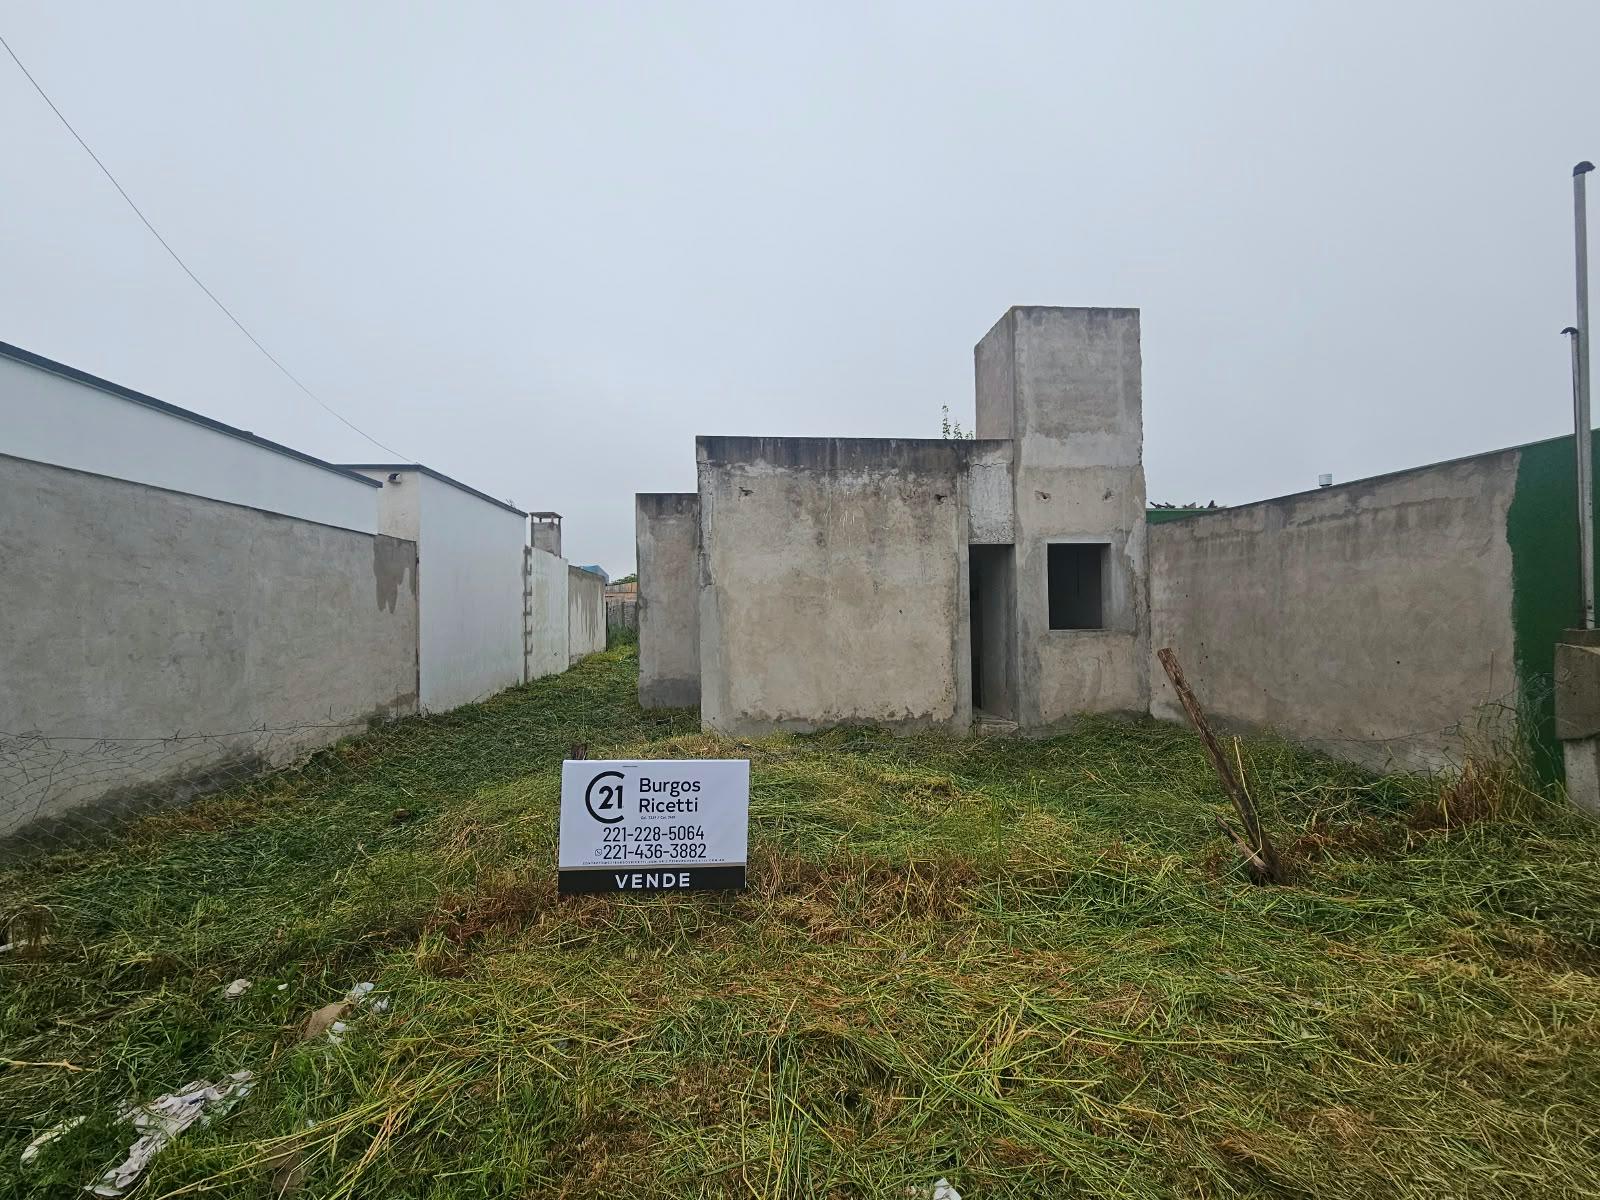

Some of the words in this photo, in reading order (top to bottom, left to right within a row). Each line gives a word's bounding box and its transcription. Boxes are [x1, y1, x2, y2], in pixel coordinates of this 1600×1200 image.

[639, 777, 701, 797] Burgos
[639, 797, 698, 813] Ricetti
[603, 825, 705, 842] 221-228-5064
[603, 843, 706, 860] 221-436-3882
[615, 872, 690, 889] VENDE
